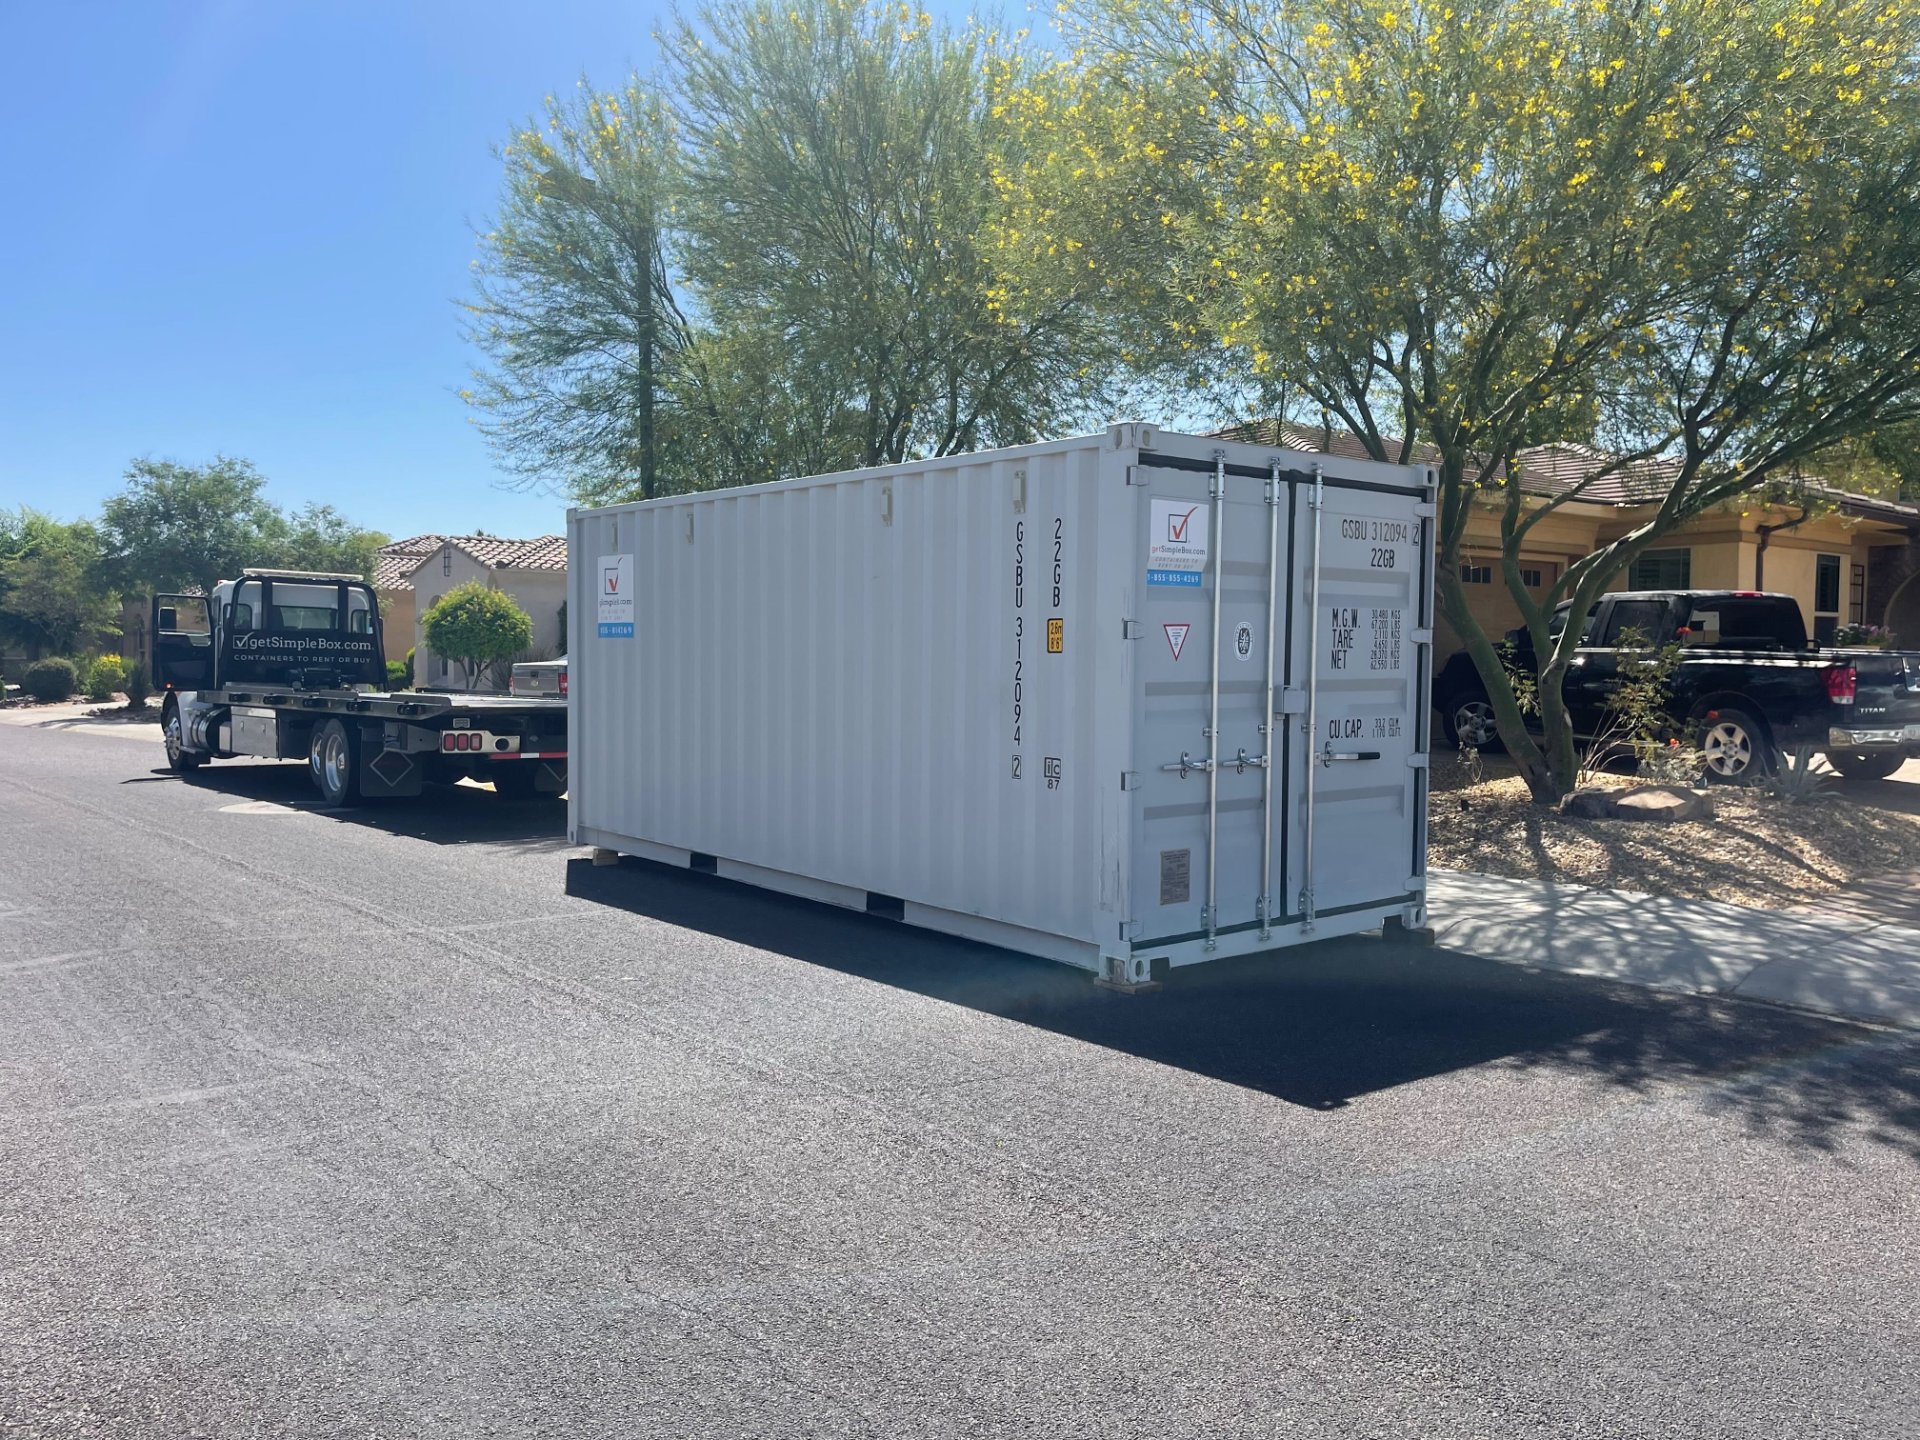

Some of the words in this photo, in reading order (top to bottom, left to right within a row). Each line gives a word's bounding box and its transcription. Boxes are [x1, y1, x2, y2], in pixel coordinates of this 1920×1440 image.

[1342, 519, 1367, 541] GSBU
[1371, 521, 1407, 544] 312094
[1152, 545, 1206, 556] getSimpleBox.com
[1370, 548, 1395, 569] 22GB
[1015, 521, 1024, 608] GSBU
[1053, 518, 1062, 607] 22GB
[1332, 607, 1361, 629] M.G.W.
[249, 636, 371, 651] getSimpleBox.com
[1332, 628, 1354, 649] TARE
[233, 654, 294, 662] CONTAINERS
[1331, 649, 1348, 670] NET
[1013, 616, 1023, 746] 312094
[1013, 757, 1021, 778] 2
